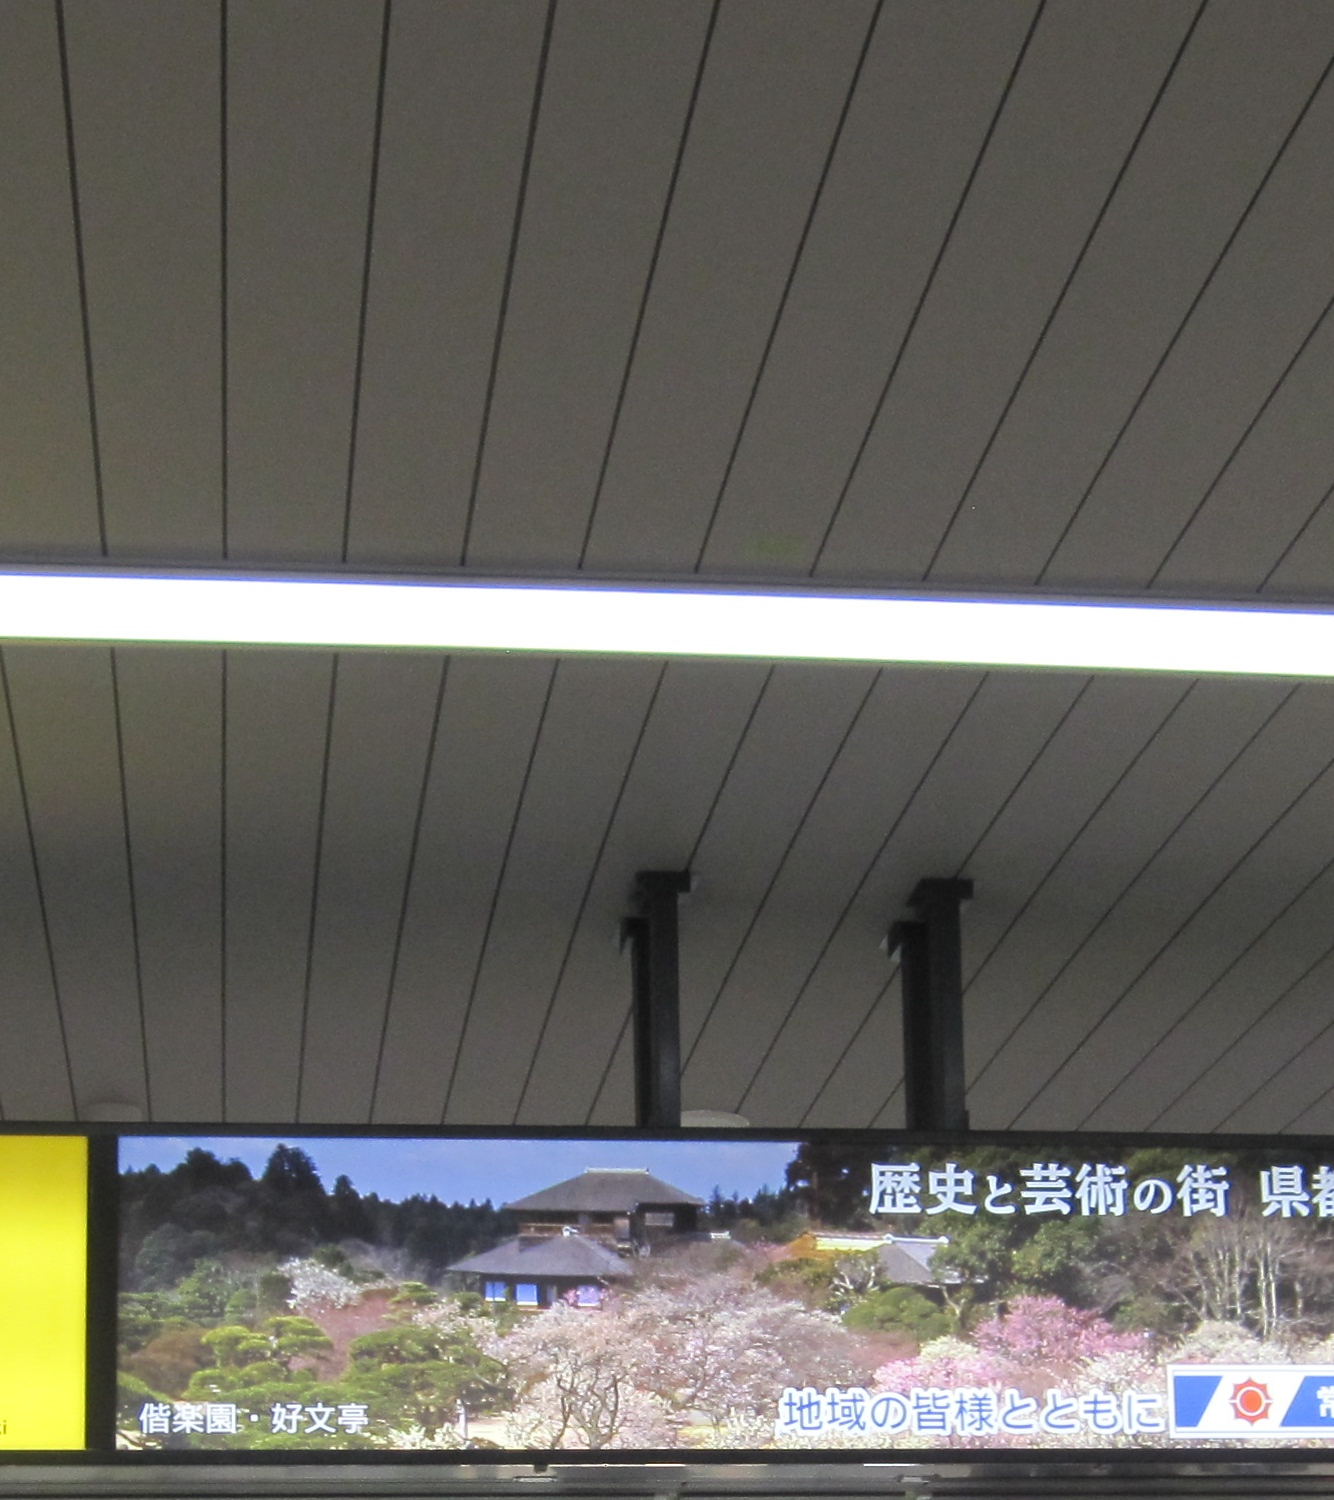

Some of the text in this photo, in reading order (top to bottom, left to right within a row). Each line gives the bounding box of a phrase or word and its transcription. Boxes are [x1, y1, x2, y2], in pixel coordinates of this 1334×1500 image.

[867, 1161, 1230, 1219] 歴史と芸術の街
[138, 1401, 369, 1435] 偕楽園・好文亭
[778, 1387, 1167, 1437] 地域の皆様とともに
